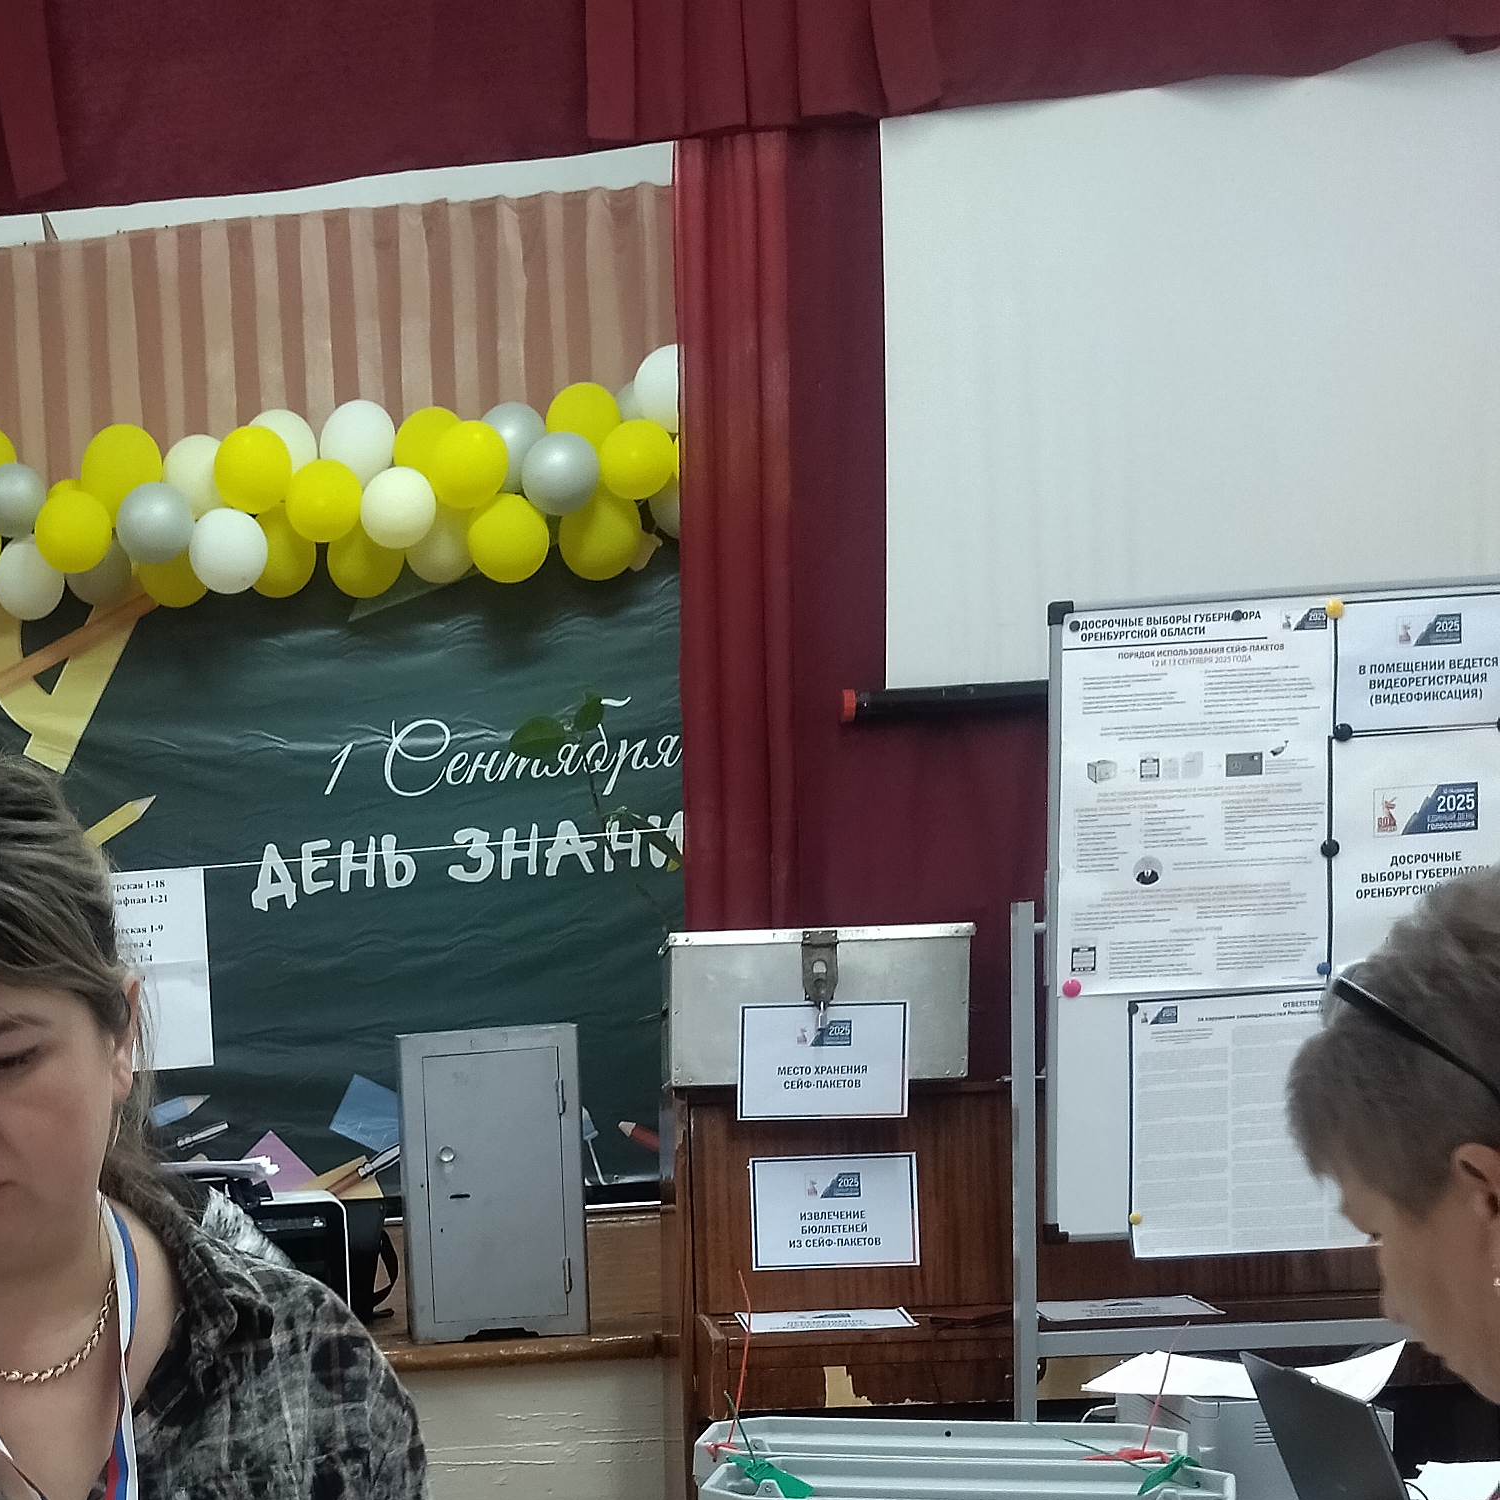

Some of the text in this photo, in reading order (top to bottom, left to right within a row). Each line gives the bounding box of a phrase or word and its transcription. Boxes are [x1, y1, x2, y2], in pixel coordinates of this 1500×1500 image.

[1080, 611, 1261, 631] ДОСРОЧНЫЕ ВЫБОРЫ ГУБЕРНОРА
[1435, 621, 1460, 632] 2025
[1081, 626, 1206, 642] ОРЕНБУРГСКОЙ ОБЛАСТИ
[1359, 656, 1499, 675] В ПОМЕЩЕНИИ ВЕДЕТСЯ
[1369, 672, 1487, 690] ВИДЕОРЕГИСТРАЦИЯ
[1370, 688, 1483, 706] (ВИДЕОФИКСАЦИЯ)
[324, 696, 683, 798] 1 Сентября
[1437, 793, 1475, 812] 2025
[1390, 851, 1462, 867] ДОСРОЧНЫЕ
[251, 833, 417, 911] ДЕНЬ
[1361, 870, 1412, 883] ВЫБОРЫ
[147, 880, 165, 888] 1-18
[150, 894, 168, 903] 1-21
[150, 924, 163, 933] 1-9
[828, 1025, 851, 1036] 2025
[777, 1064, 868, 1076] МЕСТО ХРАНЕНИЯ
[783, 1078, 861, 1090] СЕЙФ-ПАКЕТОВ
[838, 1177, 859, 1188] 2025
[800, 1210, 866, 1222] ИЗВЛЕЧЕНИЕ
[801, 1223, 868, 1235] БЮЛЛЕТЕНЕЙ
[788, 1236, 882, 1249] ИЗ СЕЙФ-ПАКЕТОВ
